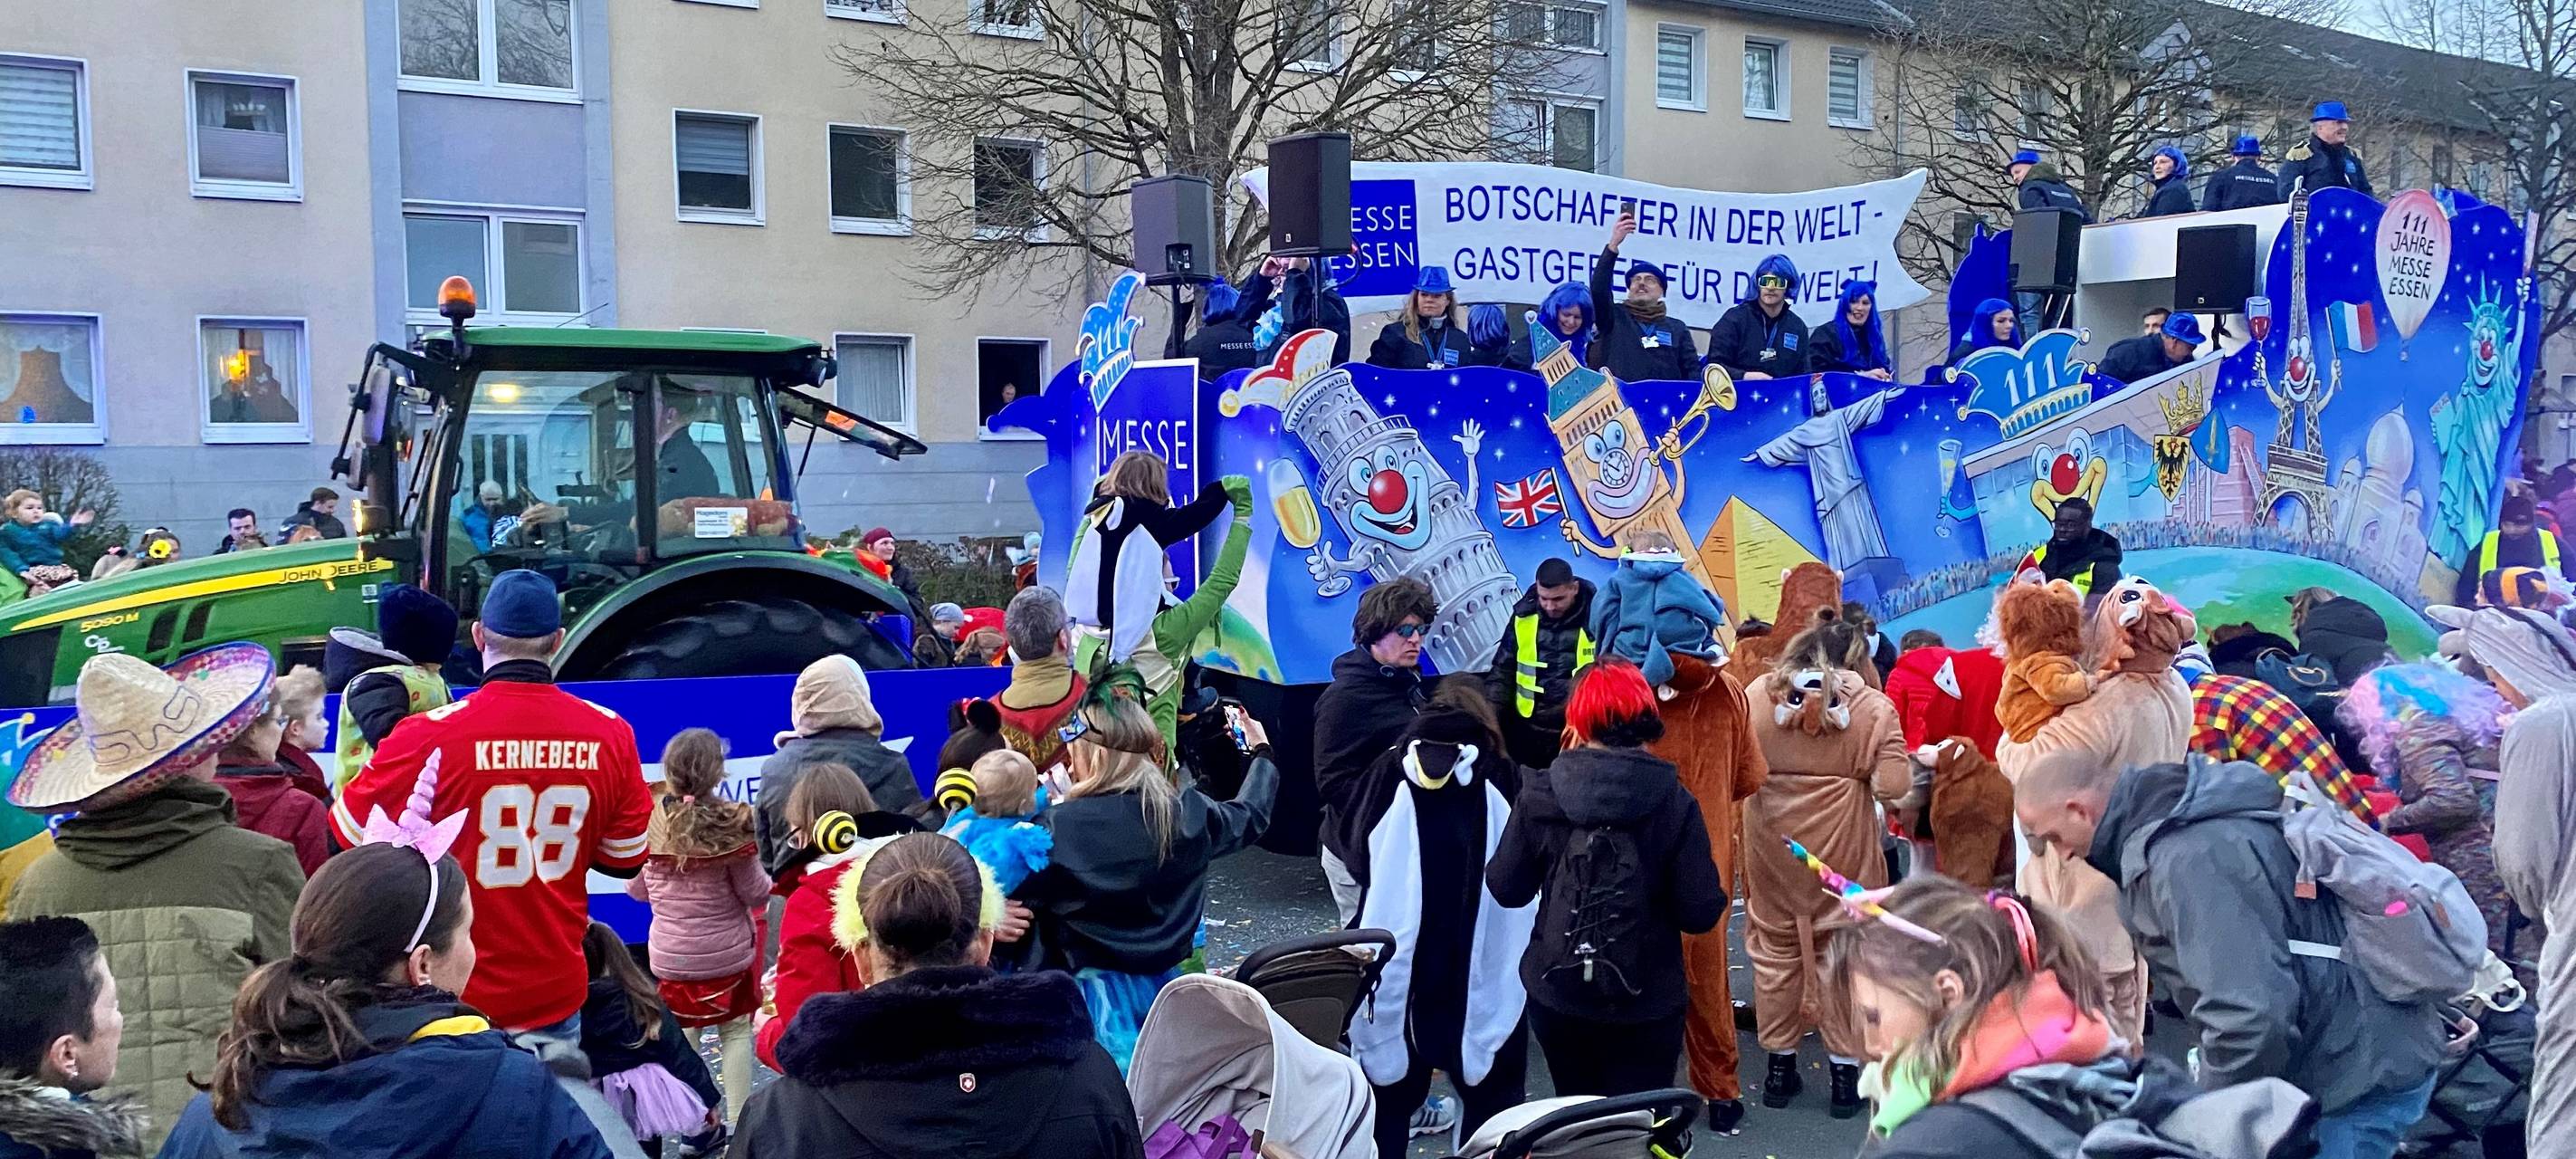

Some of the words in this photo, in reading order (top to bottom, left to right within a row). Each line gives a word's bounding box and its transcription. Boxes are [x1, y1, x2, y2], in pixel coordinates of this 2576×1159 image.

[1350, 206, 1412, 232] ESSE
[1689, 206, 1716, 242] IN
[1726, 208, 1785, 246] DER
[1795, 200, 1866, 244] WELT
[2403, 211, 2429, 235] 111
[2390, 231, 2435, 256] JAHRE
[1454, 246, 1649, 293] GASTGEE
[1664, 261, 1722, 304] FÜR
[2390, 255, 2432, 279] MESSE
[2390, 277, 2432, 301] ESSEN
[1095, 314, 1122, 364] 111
[2004, 352, 2058, 407] 111
[1102, 419, 1188, 470] MESSE
[279, 568, 322, 582] JOHN
[475, 740, 601, 771] KERNEBECK
[476, 784, 591, 889] 88
